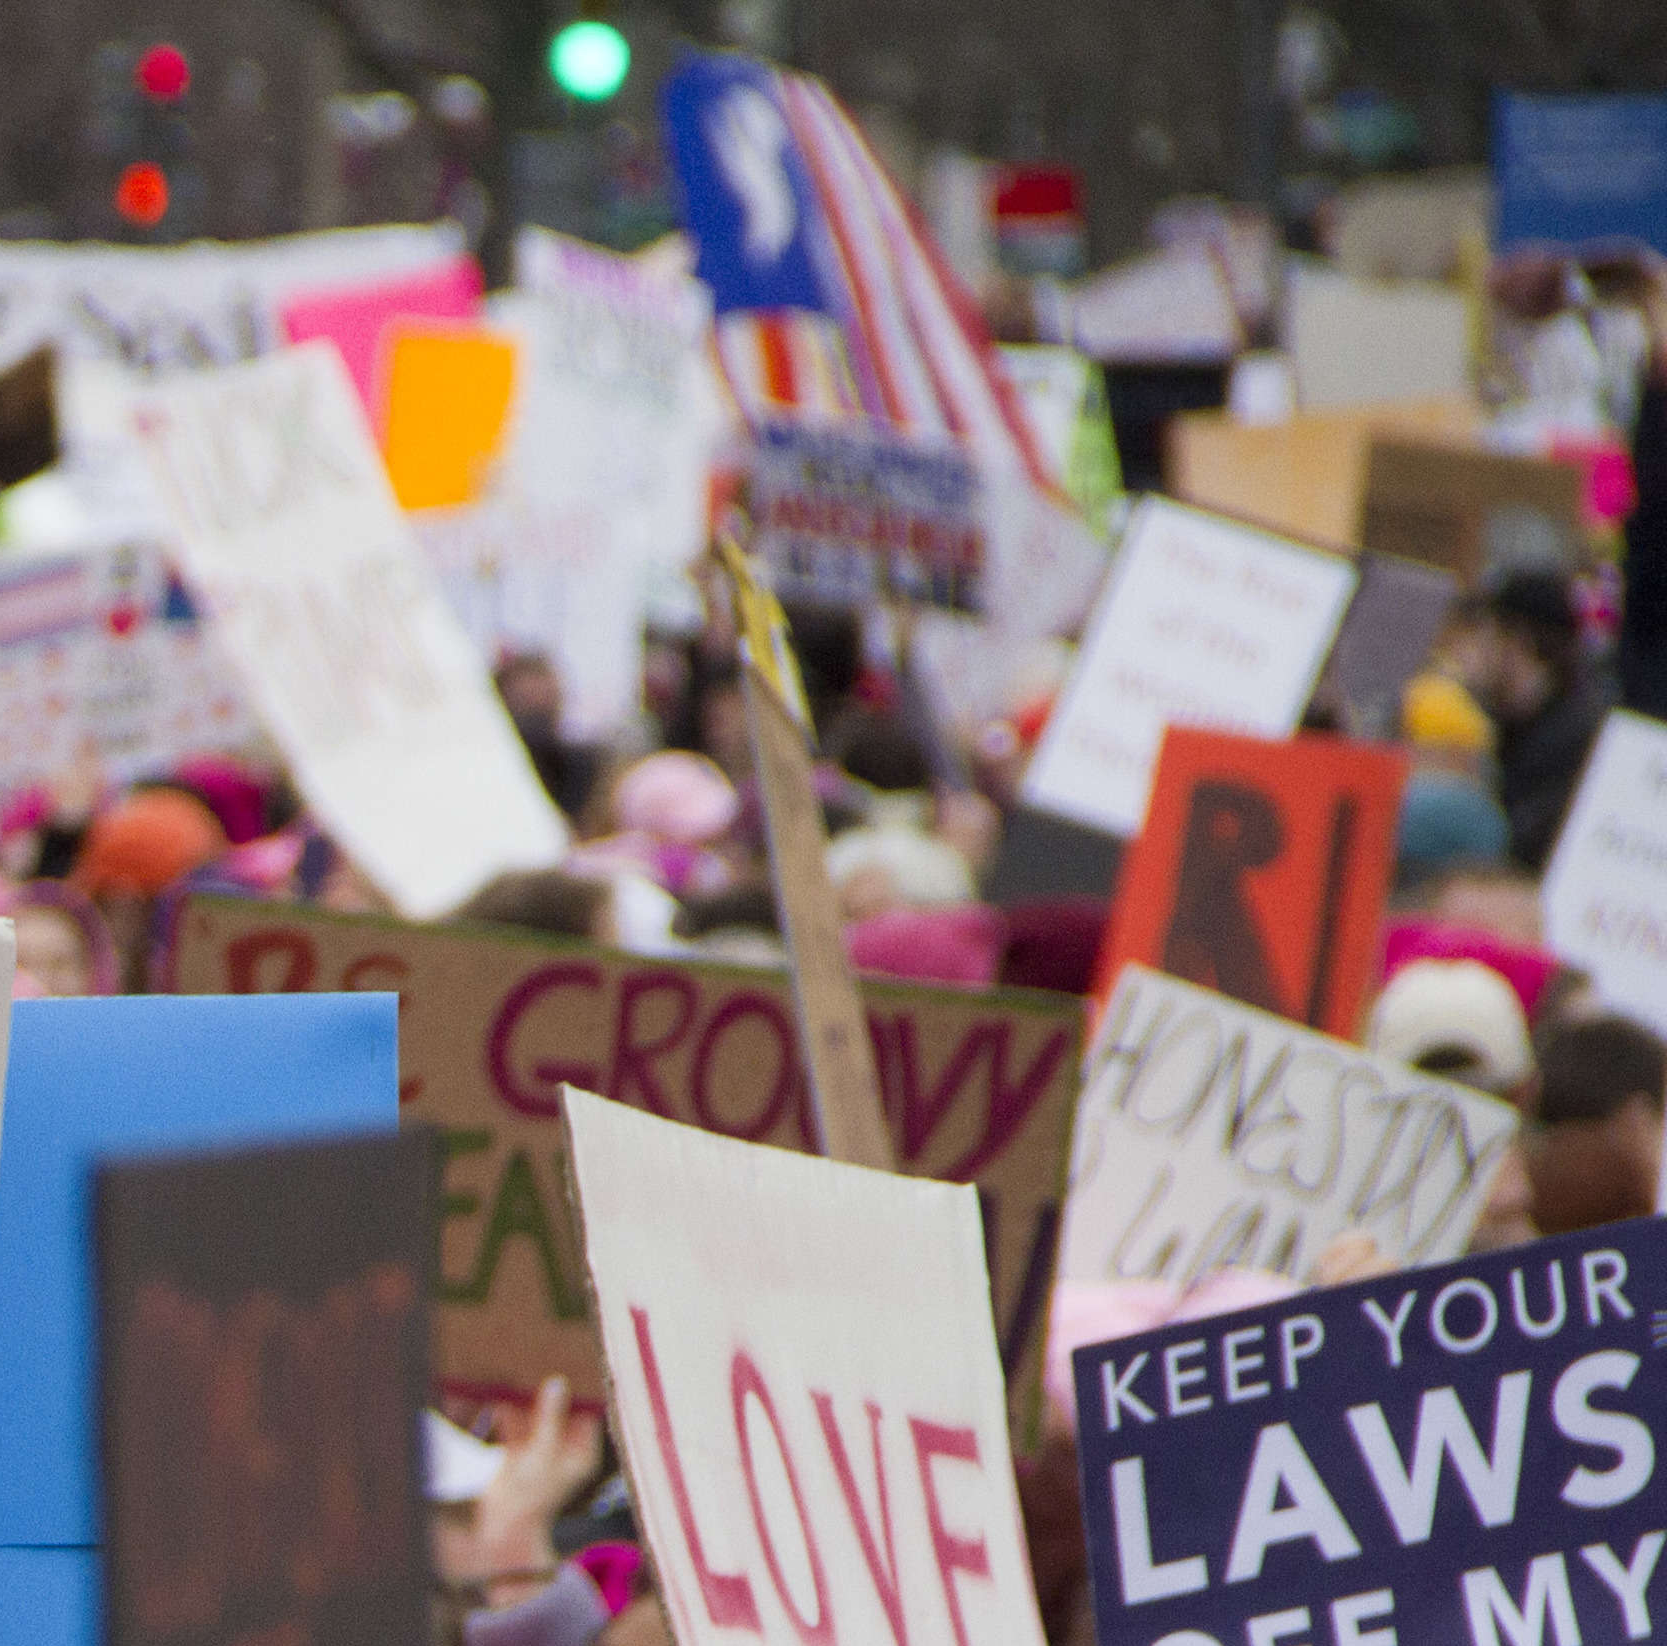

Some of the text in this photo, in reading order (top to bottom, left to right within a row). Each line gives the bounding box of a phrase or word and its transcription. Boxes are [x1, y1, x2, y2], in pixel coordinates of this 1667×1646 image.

[1101, 1249, 1635, 1431] KEEP YOUR
[1109, 1349, 1656, 1606] LAWS
